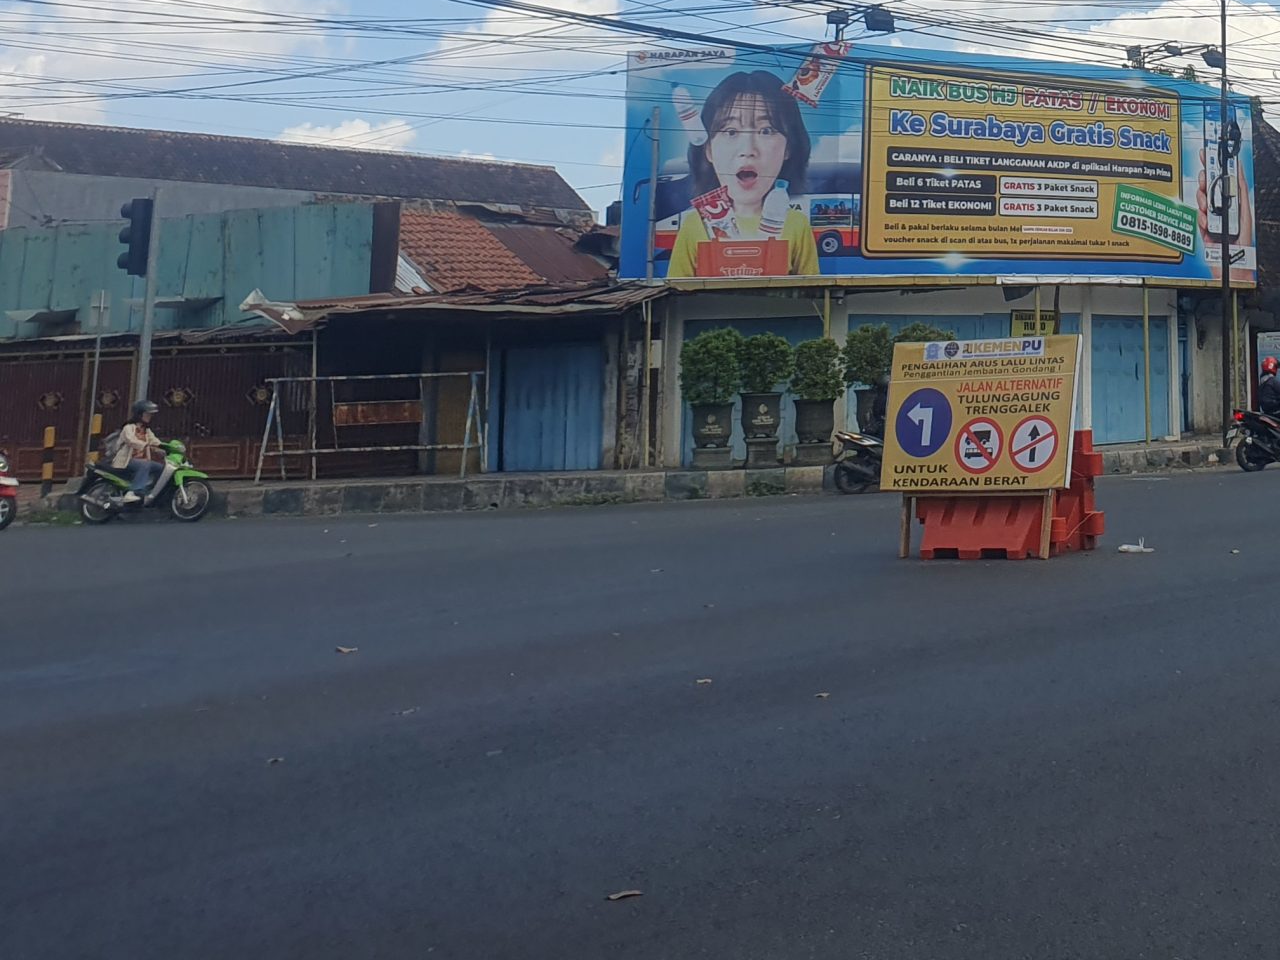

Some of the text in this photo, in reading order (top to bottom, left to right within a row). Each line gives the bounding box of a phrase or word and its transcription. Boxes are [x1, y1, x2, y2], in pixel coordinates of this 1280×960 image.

[891, 77, 945, 100] NAIK
[946, 81, 989, 102] BUS
[991, 84, 1018, 104] HJ
[1023, 88, 1082, 110] PATAS
[1105, 96, 1171, 120] EKONOMI
[890, 110, 1172, 154] Ke Surabaya Gratis Snack
[891, 152, 937, 163] CARANYA
[943, 155, 964, 165] BELI
[965, 156, 991, 166] TIKET
[992, 157, 1046, 169] LANGGANAN
[1046, 160, 1070, 170] AKDP
[1072, 161, 1080, 170] di
[1081, 161, 1111, 173] aplikasi
[1112, 164, 1143, 175] Harapan
[1143, 167, 1156, 177] Jaya
[1156, 168, 1171, 178] Prima
[896, 177, 982, 189] Beli 6 Tiket PATAS
[1003, 181, 1036, 191] GRATIS
[1044, 184, 1068, 193] Paket
[1070, 184, 1095, 194] Snack
[889, 199, 992, 211] Beli 12 Tiket EKONOMI
[1003, 202, 1036, 211] GRATIS
[1044, 204, 1068, 213] Paket
[1070, 205, 1095, 214] Snack
[1119, 202, 1157, 218] CUSTOMER
[1157, 212, 1179, 227] SERVICE
[908, 223, 930, 232] pakai
[931, 224, 960, 232] berlaku
[988, 224, 1009, 232] bulan
[1120, 214, 1192, 247] 0815-1598-8889
[883, 235, 915, 243] voucher
[1019, 237, 1055, 247] perjalanan
[1056, 238, 1088, 246] maksimal
[1111, 239, 1130, 247] snack
[1023, 321, 1046, 331] RUO
[971, 339, 1042, 354] KEMENPU
[901, 356, 1065, 371] PENGALIHAN ARUS LALU LINTAS
[903, 369, 961, 379] Penggantian
[963, 367, 1009, 376] Jembatan
[1011, 365, 1056, 375] Gondang
[956, 378, 1064, 393] JALAN ALTERNATIF
[957, 391, 1061, 405] TULUNGAGUNG
[964, 402, 1051, 416] TRENGGALEK
[893, 464, 949, 474] UNTUK
[892, 475, 1029, 487] KENDARAAN BERAT
